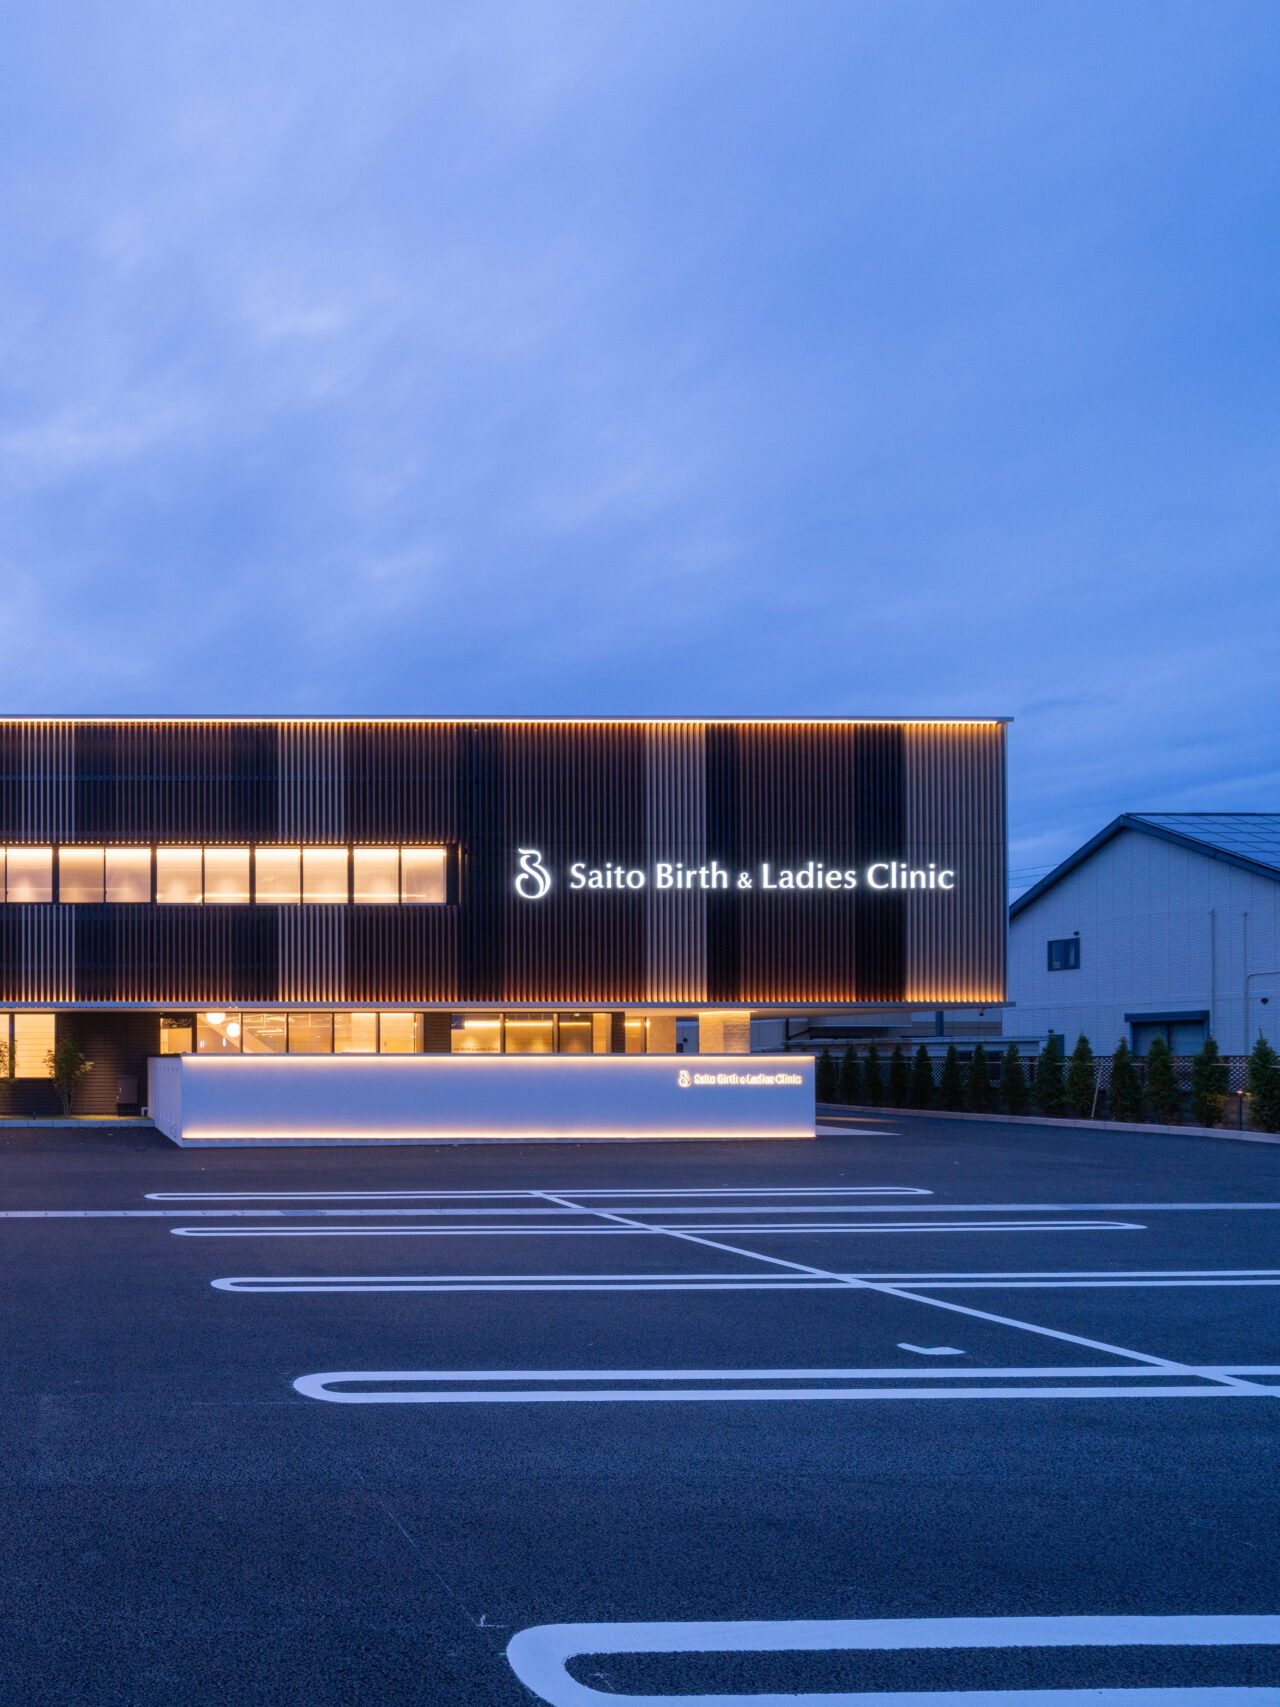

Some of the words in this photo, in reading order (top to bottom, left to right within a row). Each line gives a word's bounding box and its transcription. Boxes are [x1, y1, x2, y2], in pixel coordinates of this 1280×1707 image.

[569, 861, 647, 890] Saito
[655, 861, 729, 890] Birth
[736, 871, 754, 890] &
[761, 861, 858, 890] Ladies
[865, 861, 955, 890] Clinic
